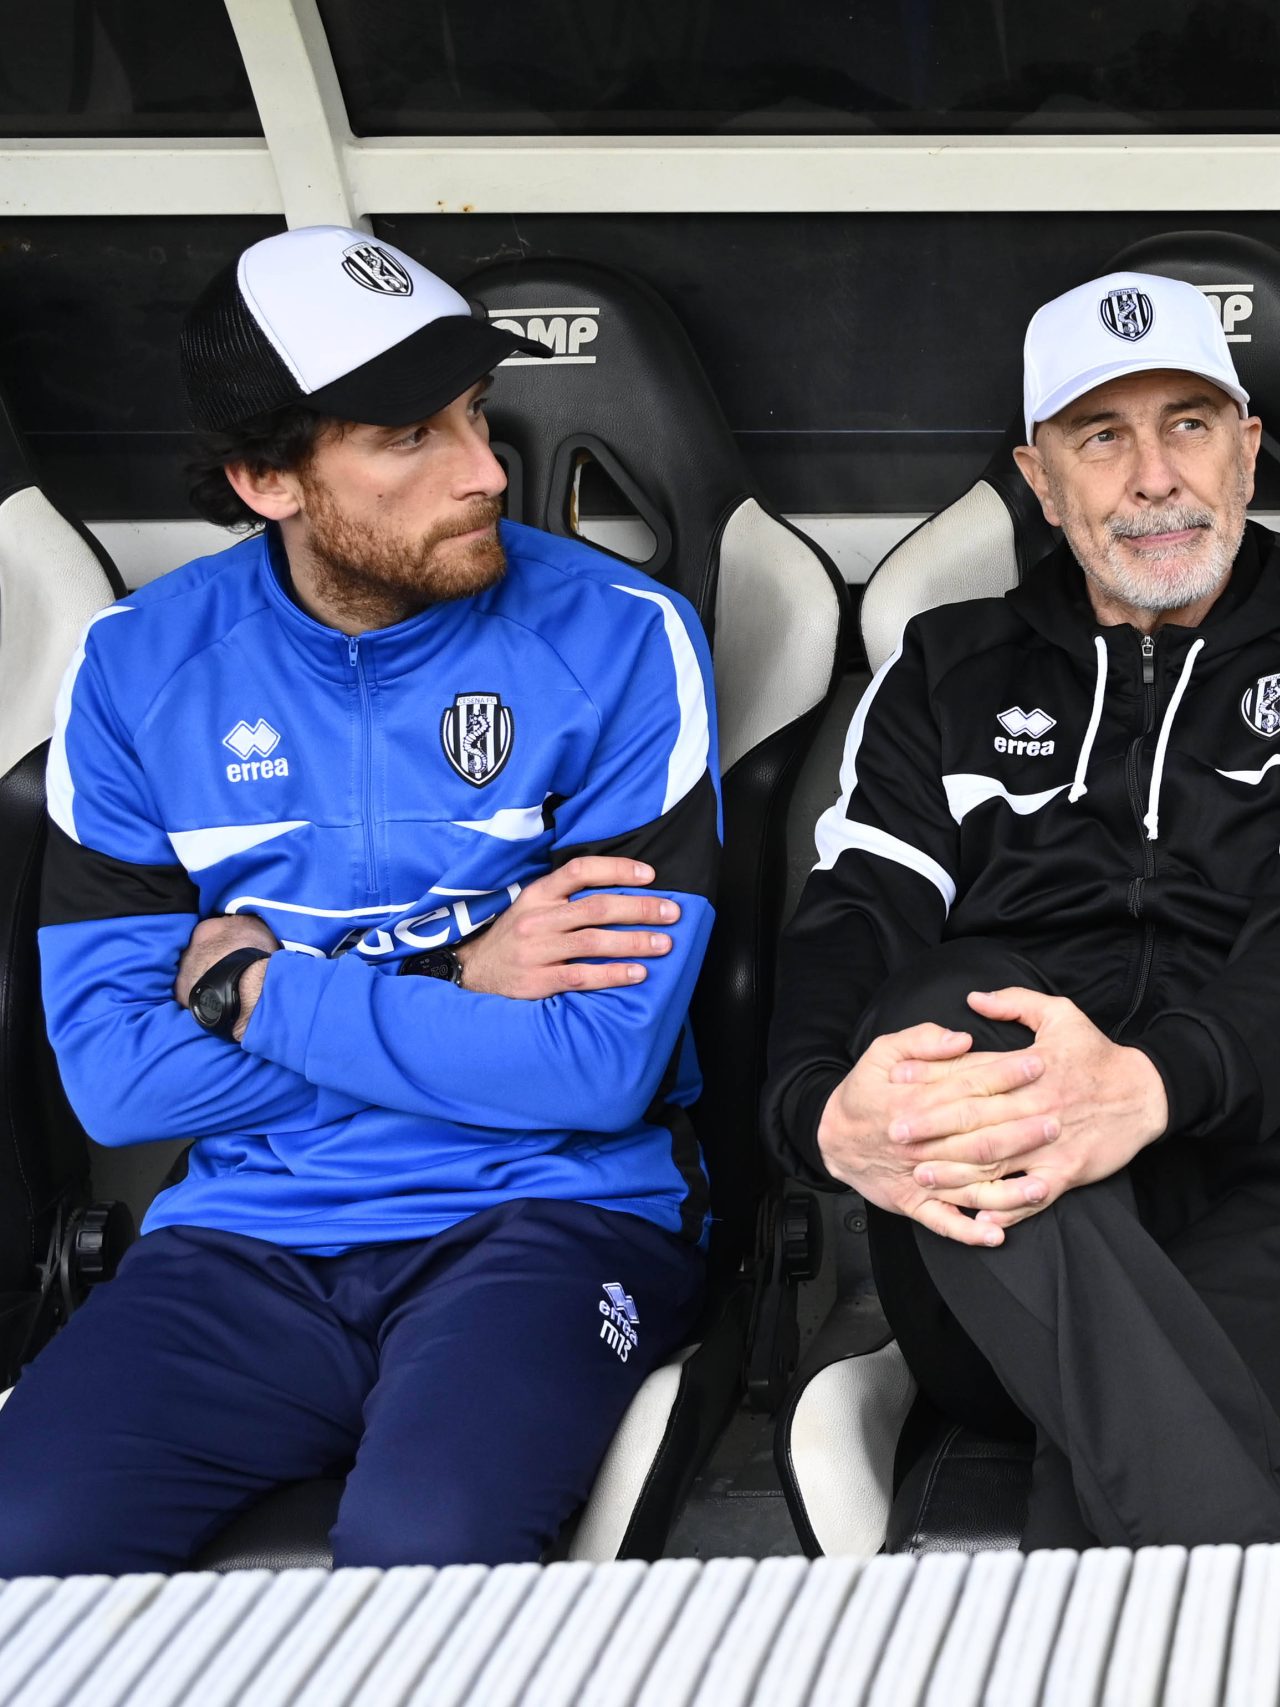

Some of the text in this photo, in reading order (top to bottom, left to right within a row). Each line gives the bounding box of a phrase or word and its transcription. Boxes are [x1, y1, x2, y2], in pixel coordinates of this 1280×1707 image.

[994, 736, 1055, 756] errea
[226, 757, 289, 783] errea
[599, 1300, 638, 1347] errea
